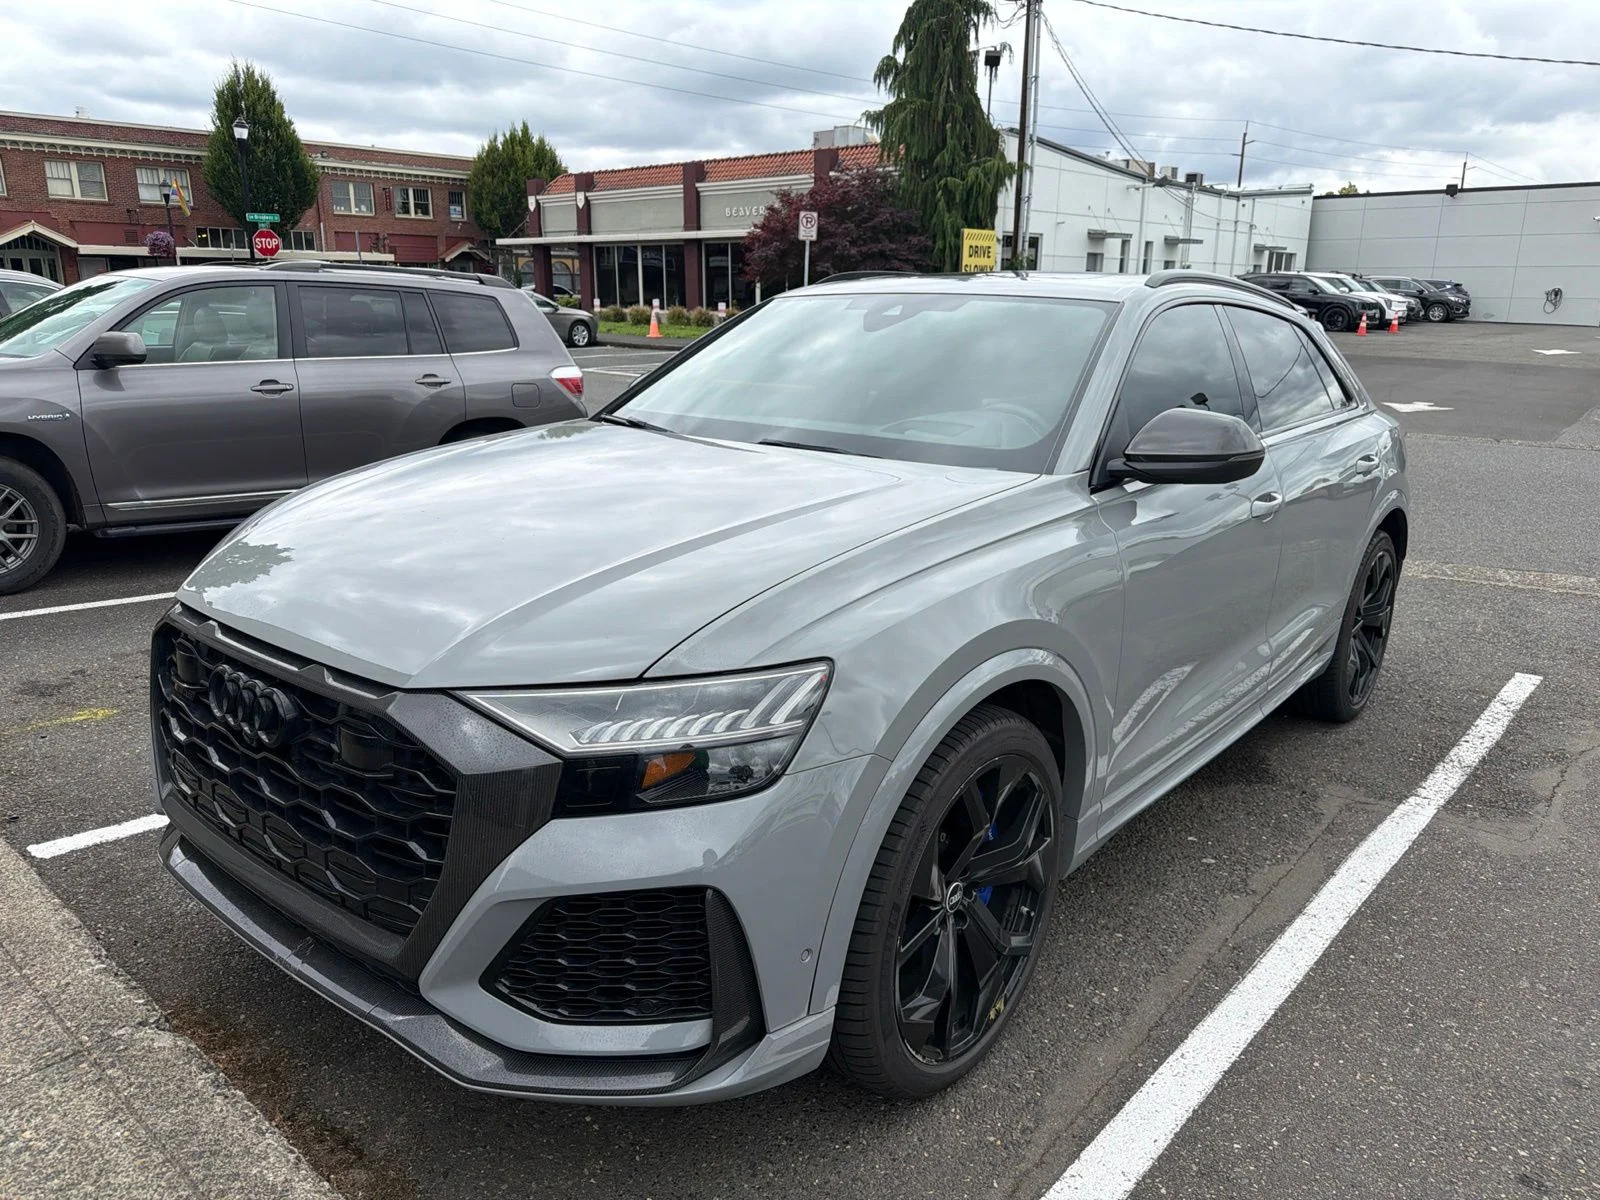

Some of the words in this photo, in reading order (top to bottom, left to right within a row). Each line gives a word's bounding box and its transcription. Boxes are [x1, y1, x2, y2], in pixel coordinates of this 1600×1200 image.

[725, 205, 766, 217] BEAVER
[255, 238, 279, 249] STOP
[968, 244, 992, 259] DRIVE
